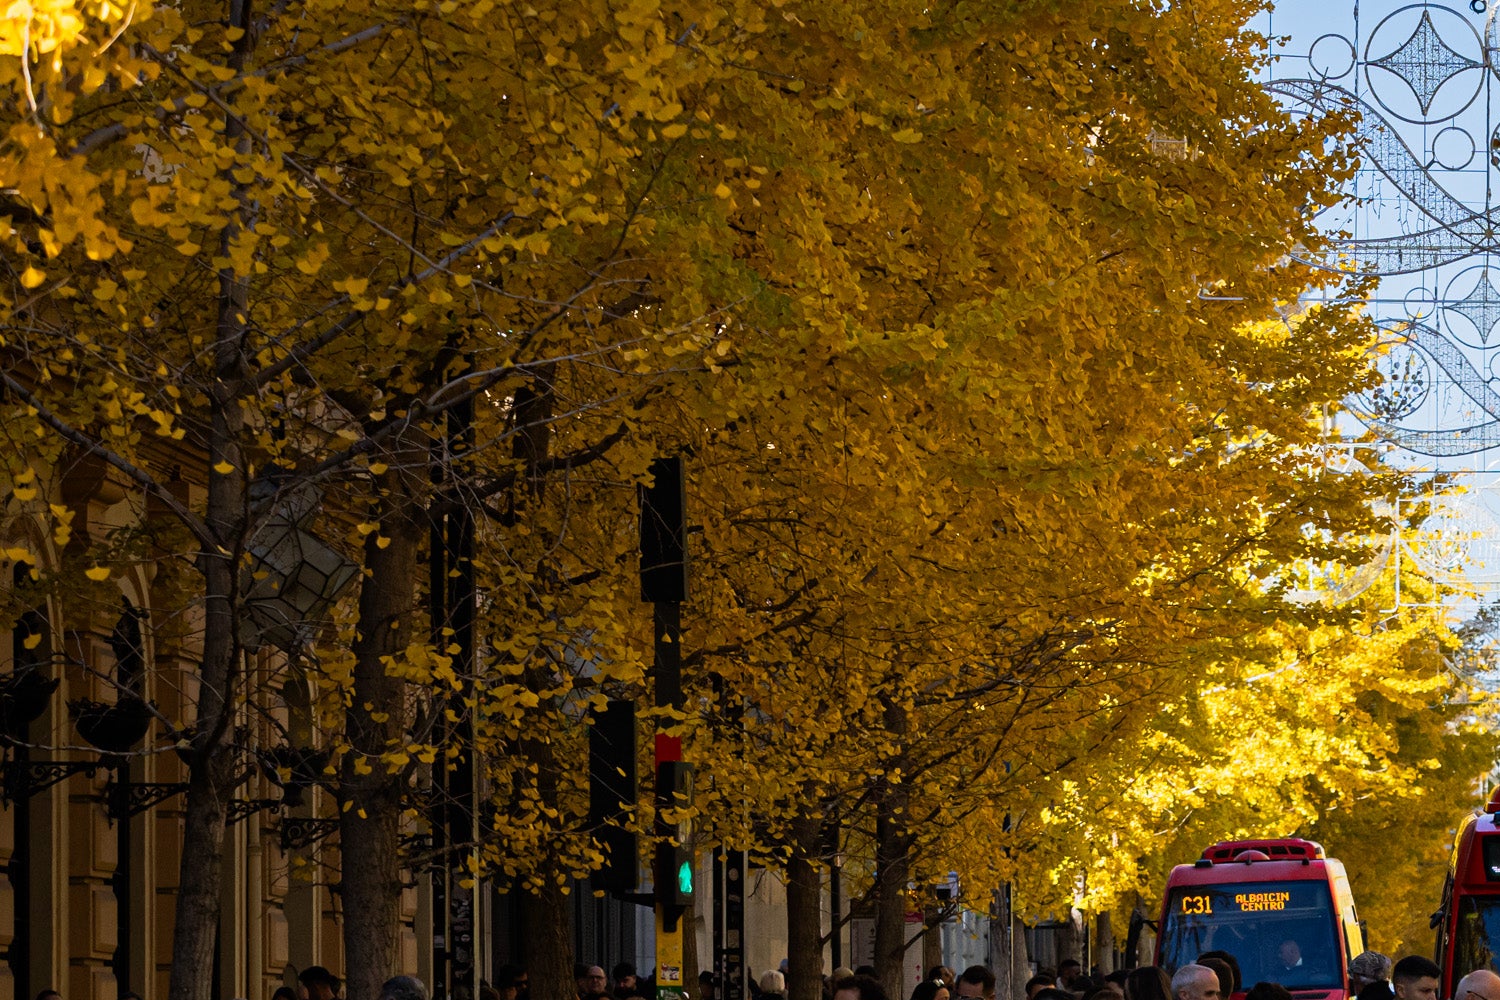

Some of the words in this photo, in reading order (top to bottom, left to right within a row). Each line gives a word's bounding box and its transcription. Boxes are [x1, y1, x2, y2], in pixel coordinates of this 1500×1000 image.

[1235, 892, 1290, 904] ALBAICIN
[1182, 895, 1213, 915] C31
[1241, 901, 1285, 912] CENTRO
